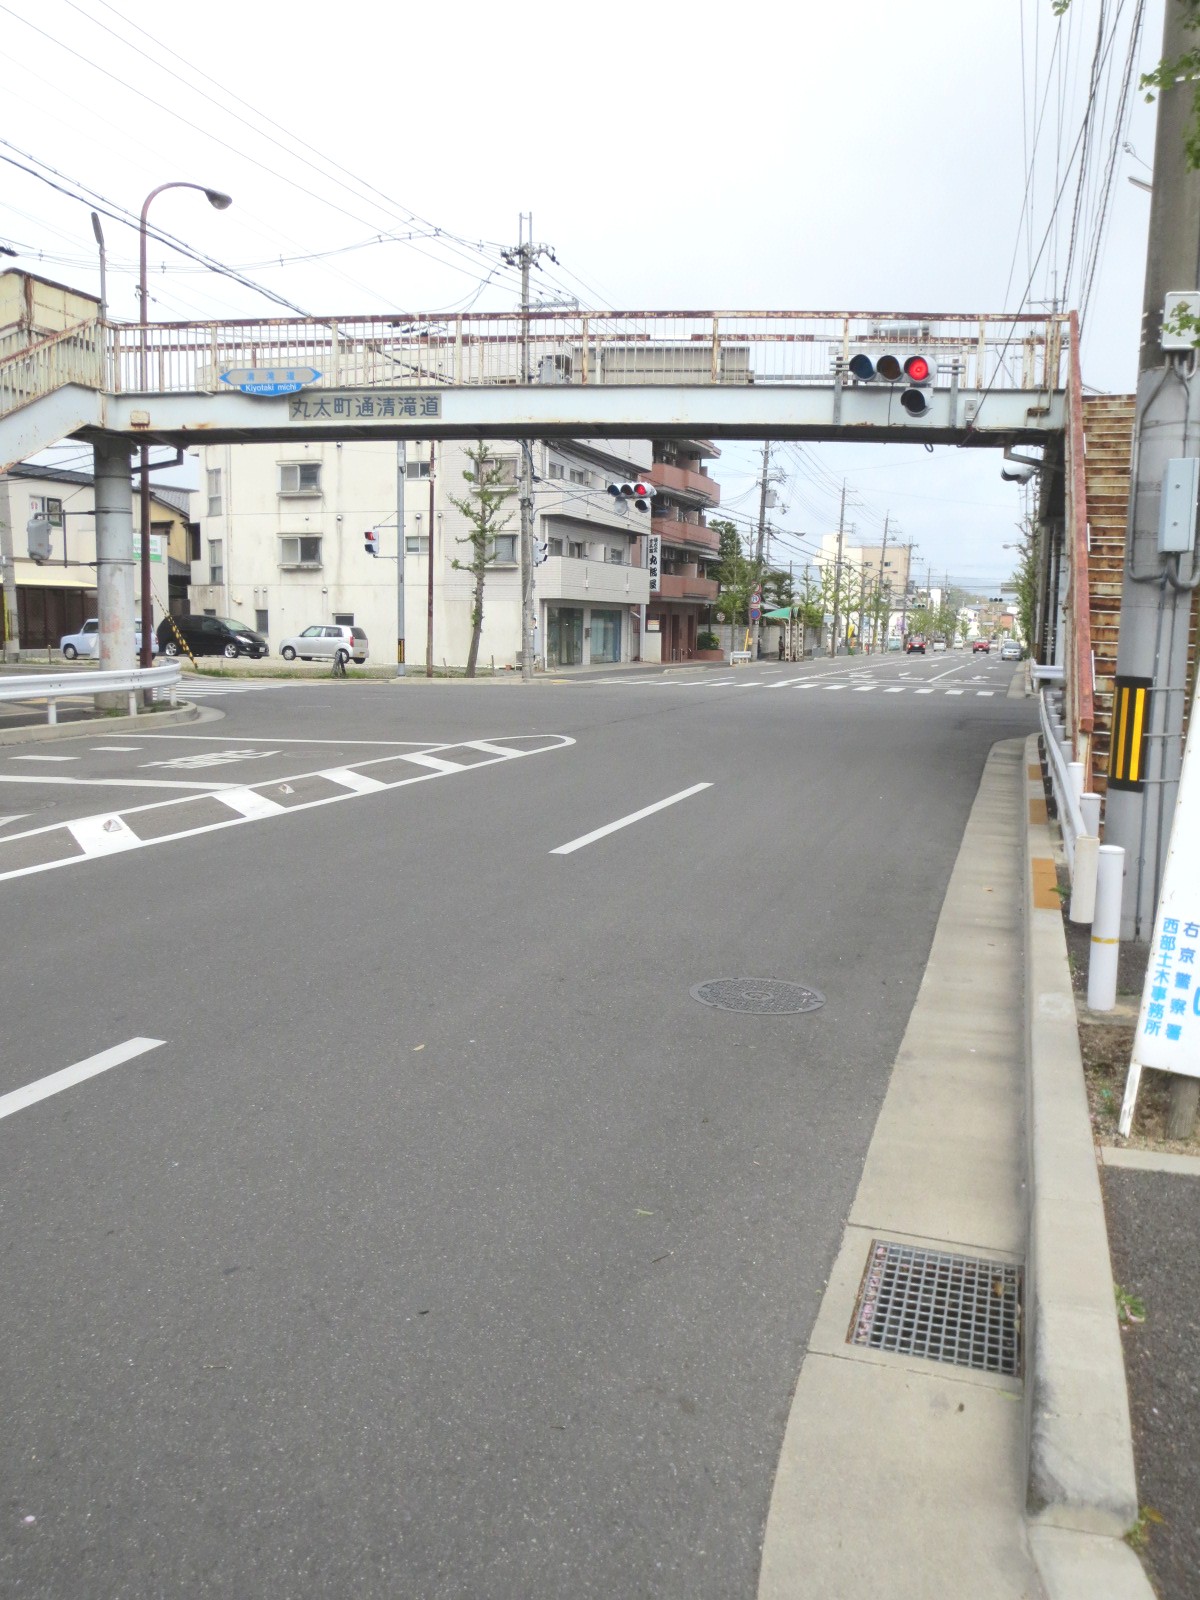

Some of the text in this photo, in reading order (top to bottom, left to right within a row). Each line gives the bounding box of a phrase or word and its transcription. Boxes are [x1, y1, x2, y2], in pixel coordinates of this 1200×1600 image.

[245, 383, 297, 393] Kiyotaki michi
[291, 395, 439, 418] 丸太町通清滝道
[1144, 917, 1180, 1037] 西部土木事務所
[1165, 921, 1200, 1041] 右京警察署
